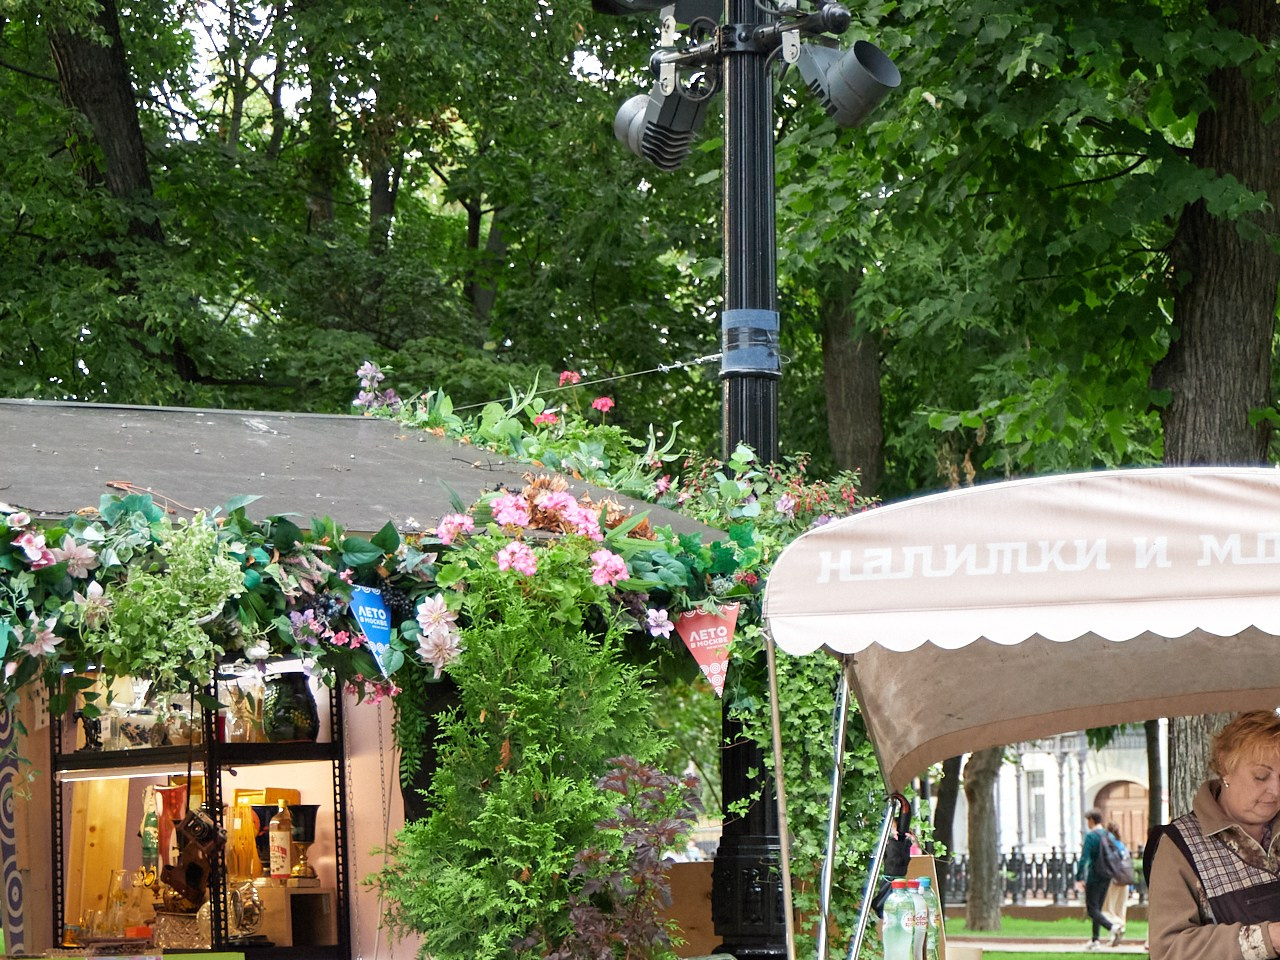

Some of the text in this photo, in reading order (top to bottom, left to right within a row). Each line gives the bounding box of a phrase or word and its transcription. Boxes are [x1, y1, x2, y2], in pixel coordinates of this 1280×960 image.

[358, 605, 387, 620] ЛЕТО
[689, 625, 728, 642] ЛЕТО
[696, 636, 728, 648] МОСКВЕ
